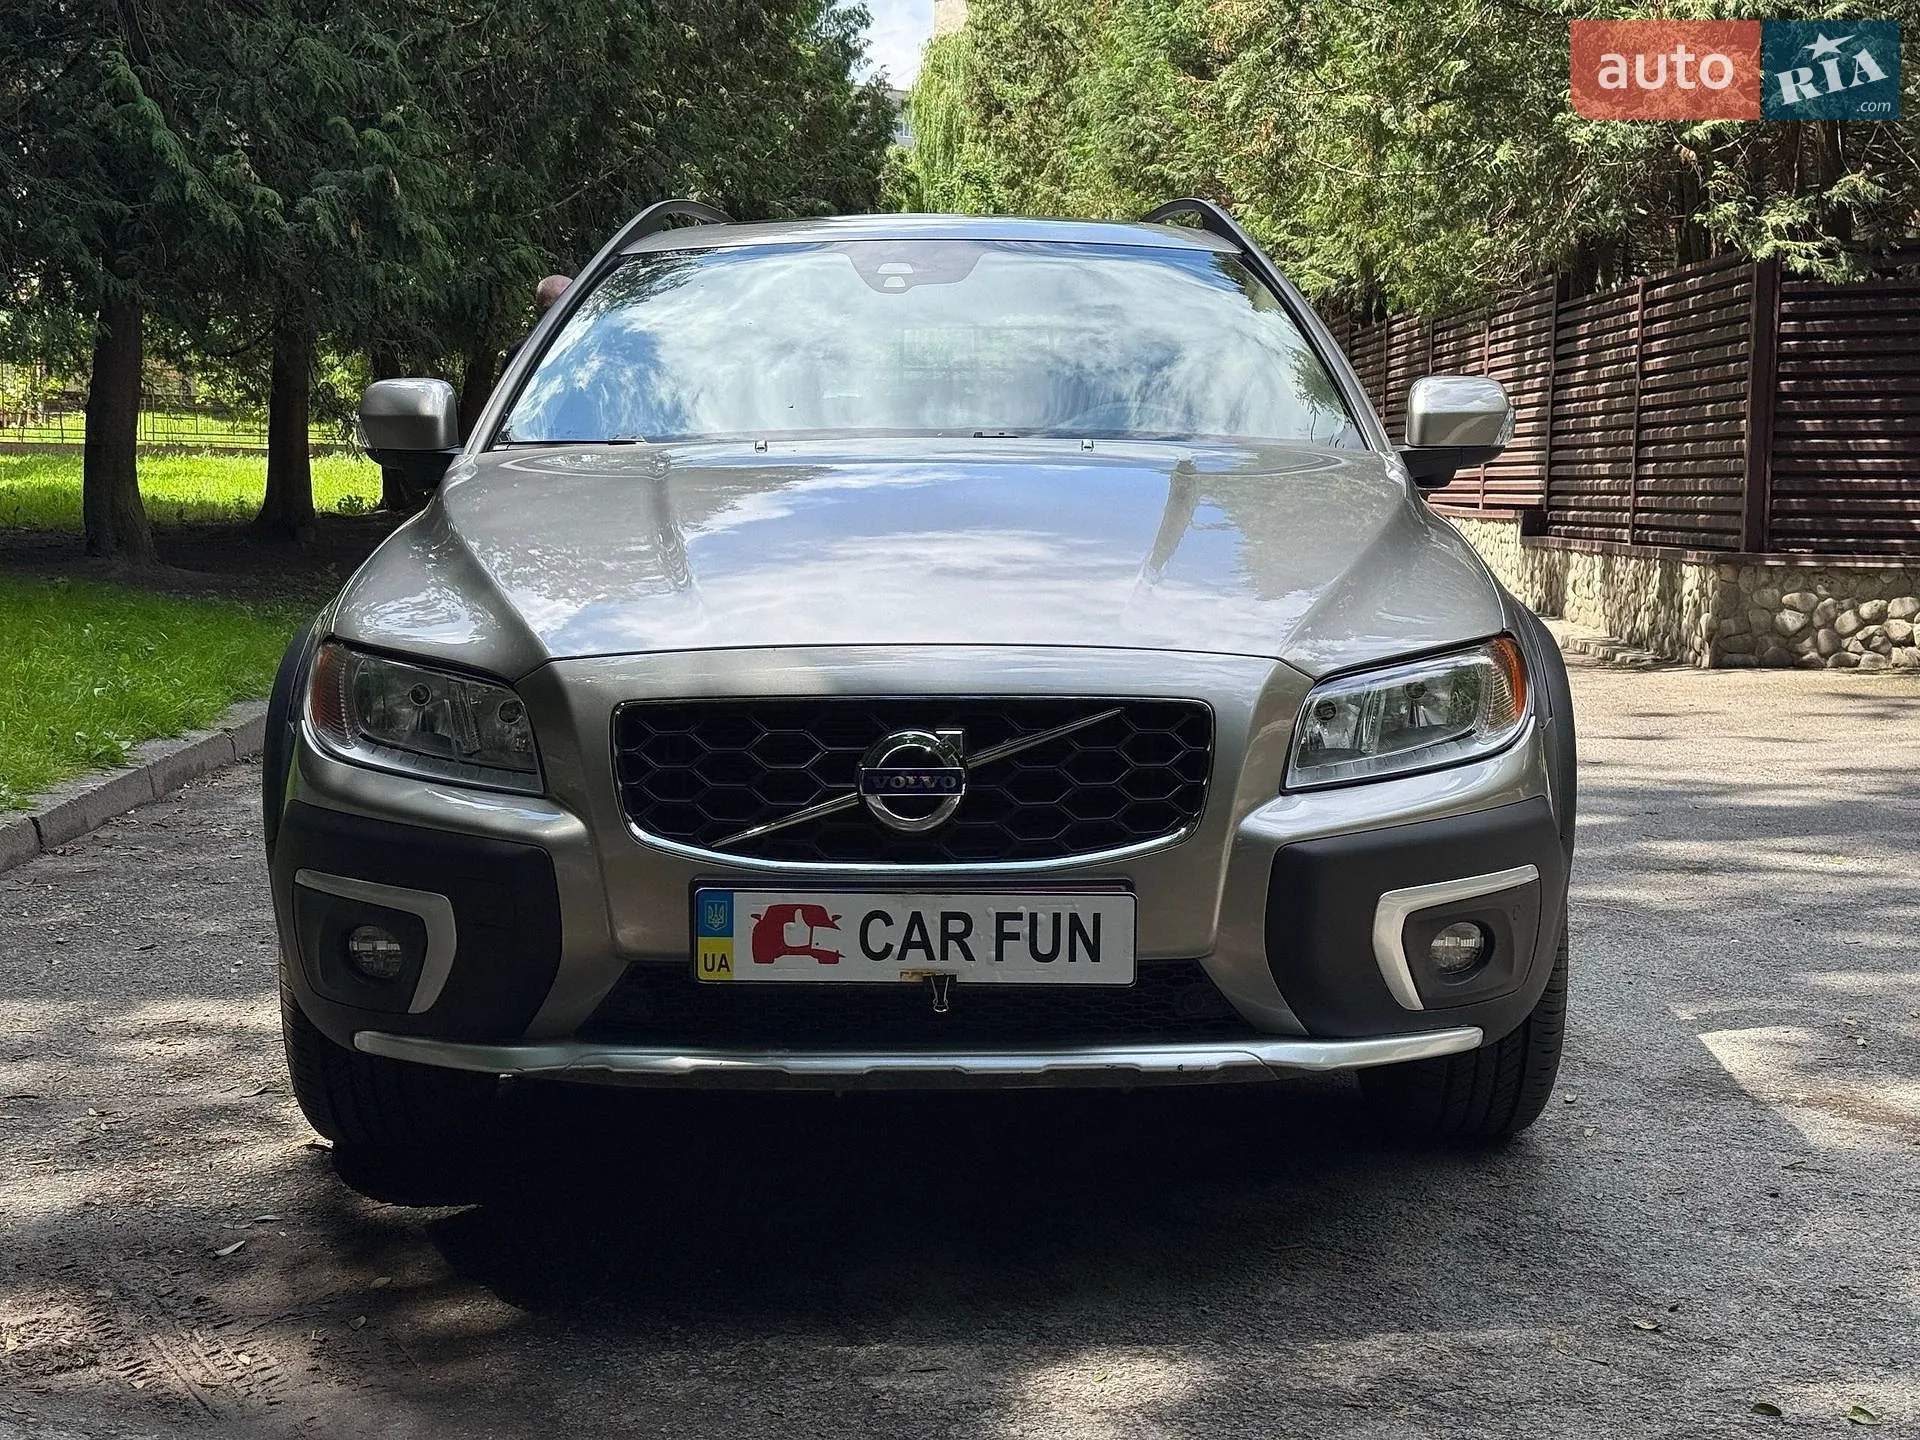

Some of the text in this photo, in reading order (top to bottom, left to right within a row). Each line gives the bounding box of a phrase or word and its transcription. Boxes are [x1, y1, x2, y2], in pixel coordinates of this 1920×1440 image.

[870, 775, 957, 789] VOLVO
[859, 910, 1101, 963] CAR FUN
[704, 953, 731, 973] UA
